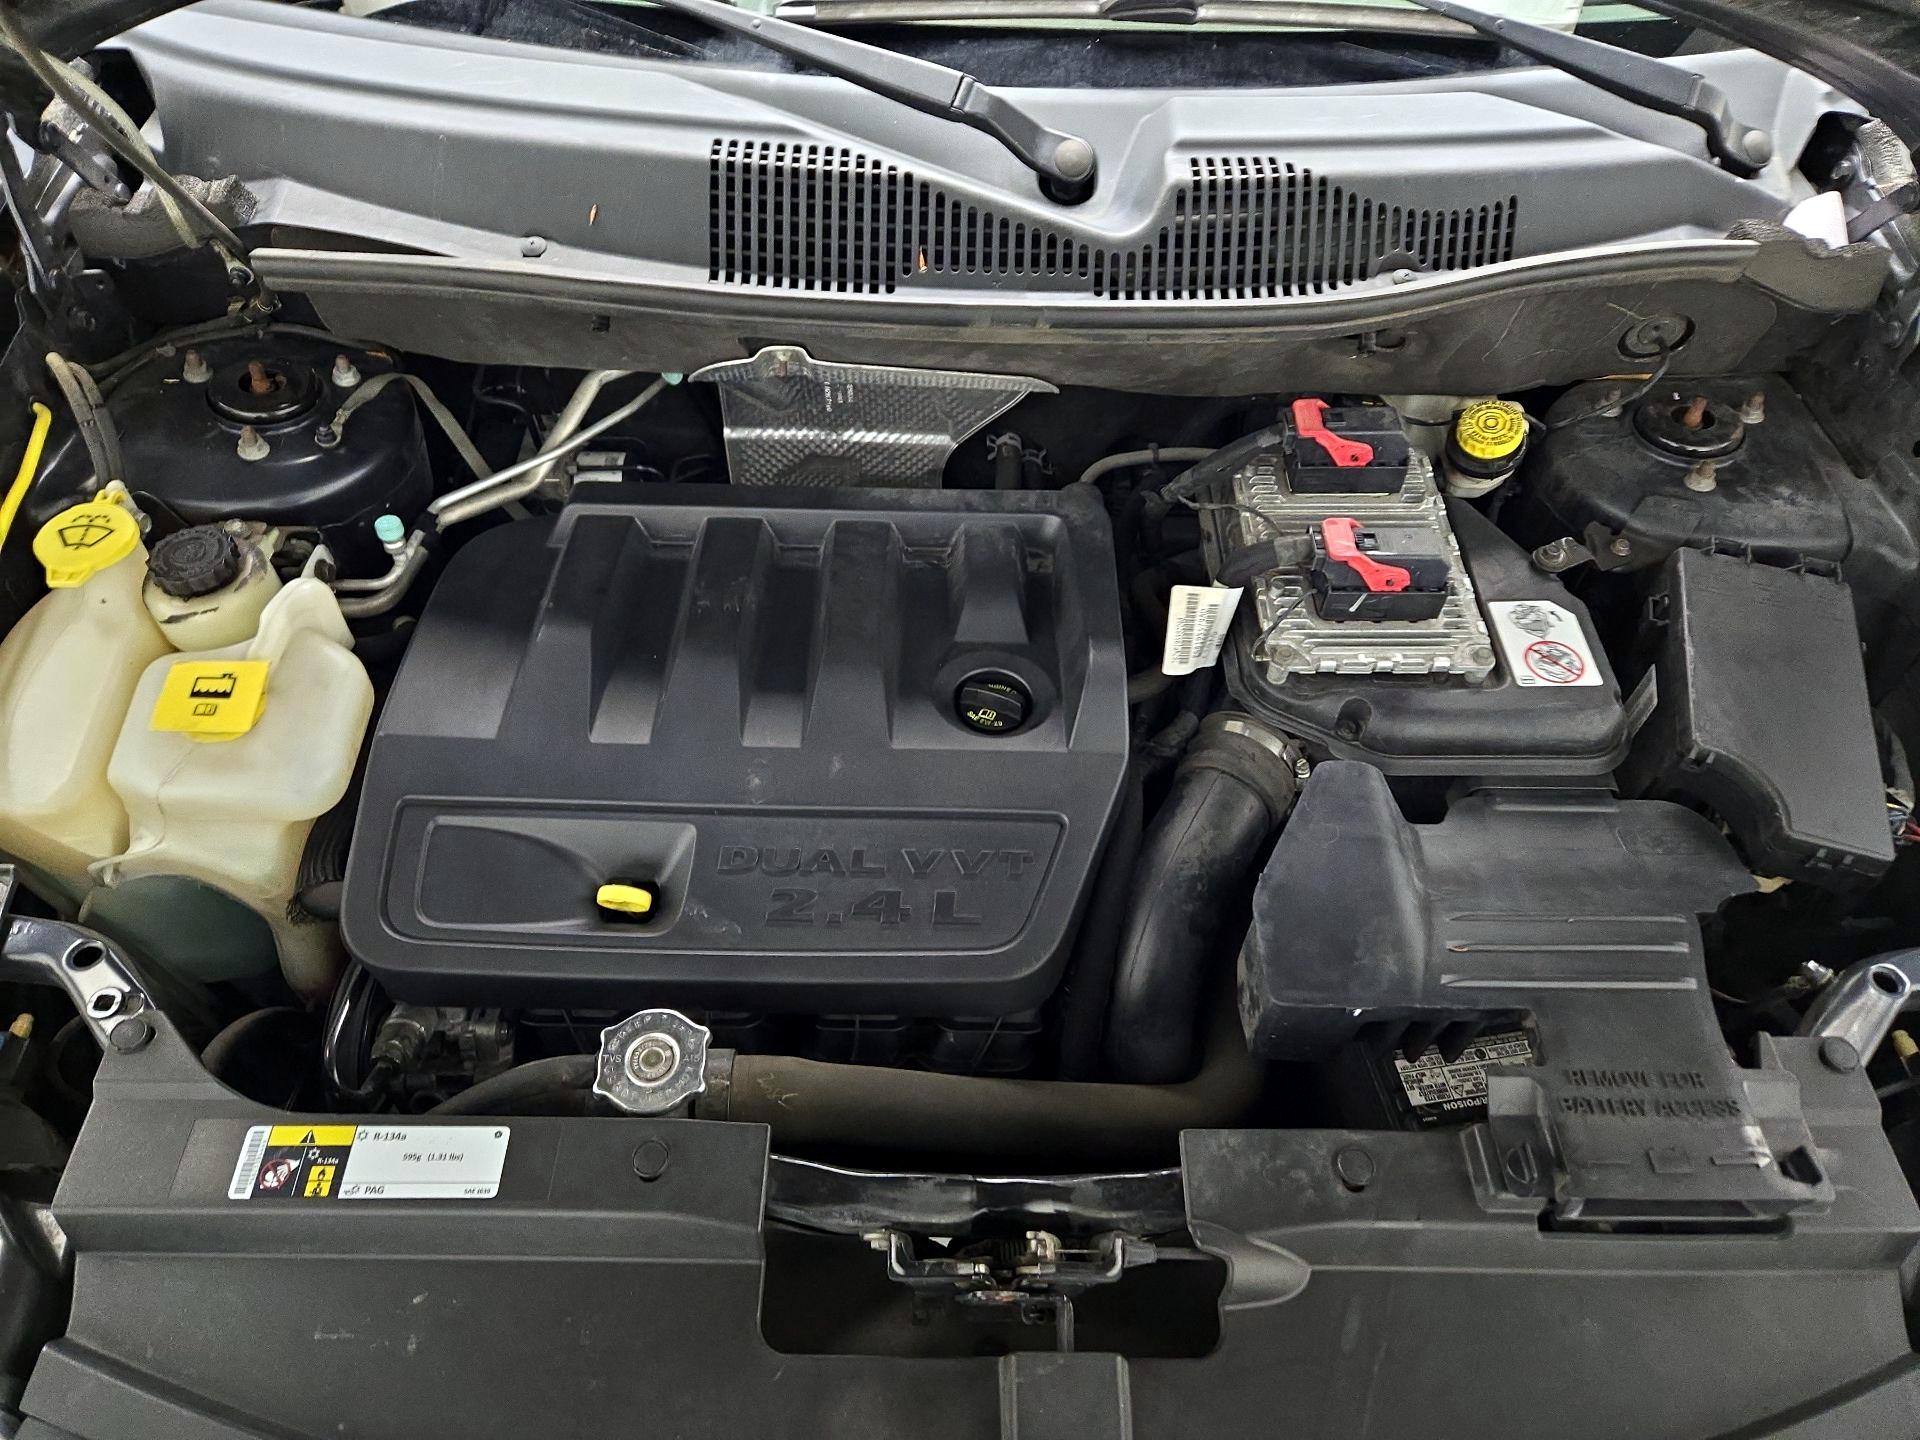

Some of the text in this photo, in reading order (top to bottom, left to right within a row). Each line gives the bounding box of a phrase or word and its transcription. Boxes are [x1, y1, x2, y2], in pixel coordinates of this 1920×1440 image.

[717, 846, 1035, 877] DUAL VVT
[765, 888, 982, 926] 2.4 L
[602, 1054, 622, 1063] TVS
[1564, 1070, 1706, 1089] REMOVE FOR
[1557, 1098, 1648, 1117] BATTERY
[373, 1132, 407, 1141] R-134a
[364, 1186, 385, 1195] PAG
